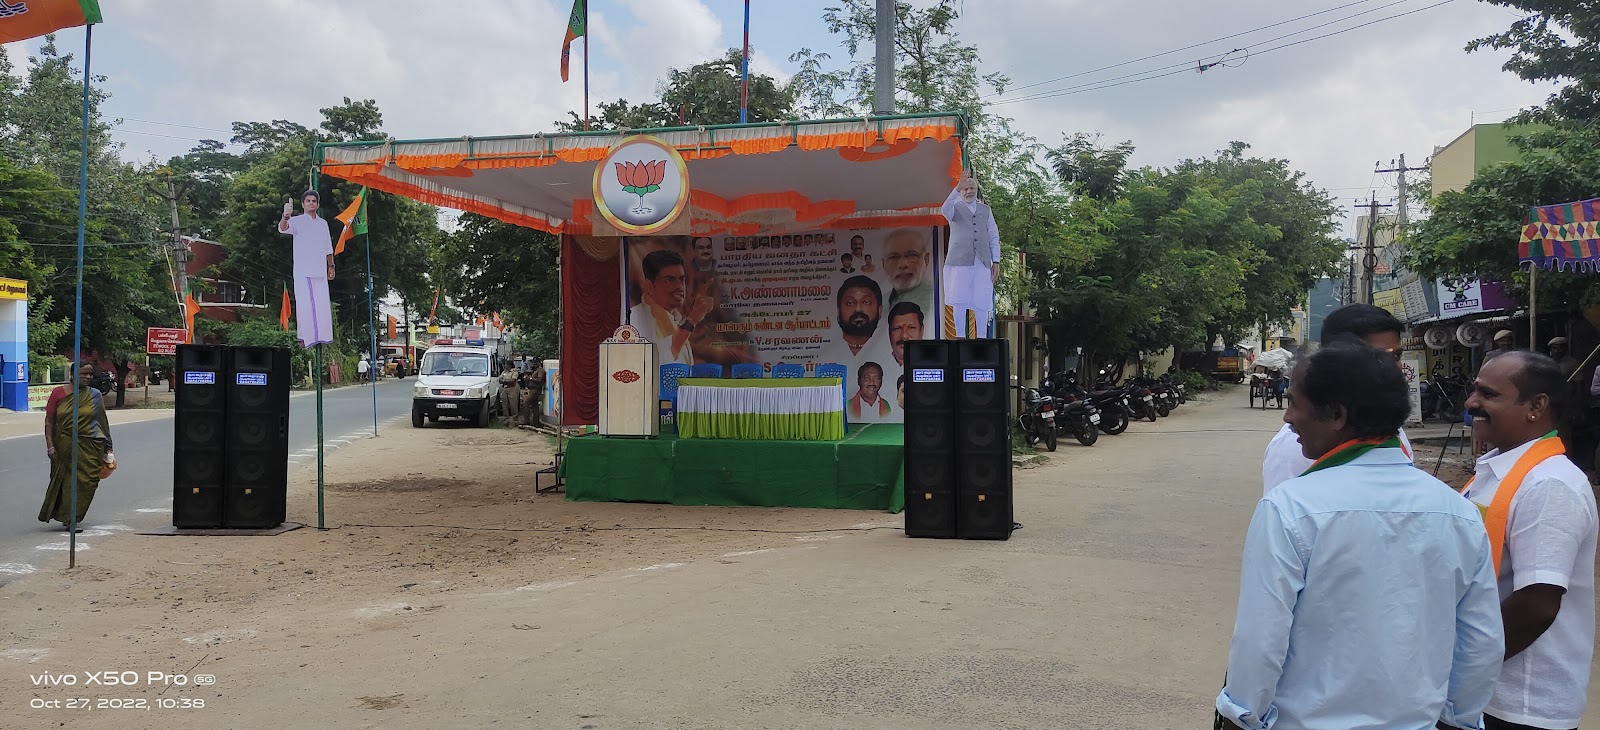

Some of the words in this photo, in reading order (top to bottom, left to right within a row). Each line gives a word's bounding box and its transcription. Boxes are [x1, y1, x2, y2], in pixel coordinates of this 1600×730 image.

[720, 253, 762, 261] பாரதிய
[765, 251, 806, 259] ஜனதா
[810, 248, 837, 256] கட்சி
[731, 284, 832, 300] K.அண்ணாமலை
[1458, 300, 1478, 308] CARE
[754, 319, 783, 331] கண்டன
